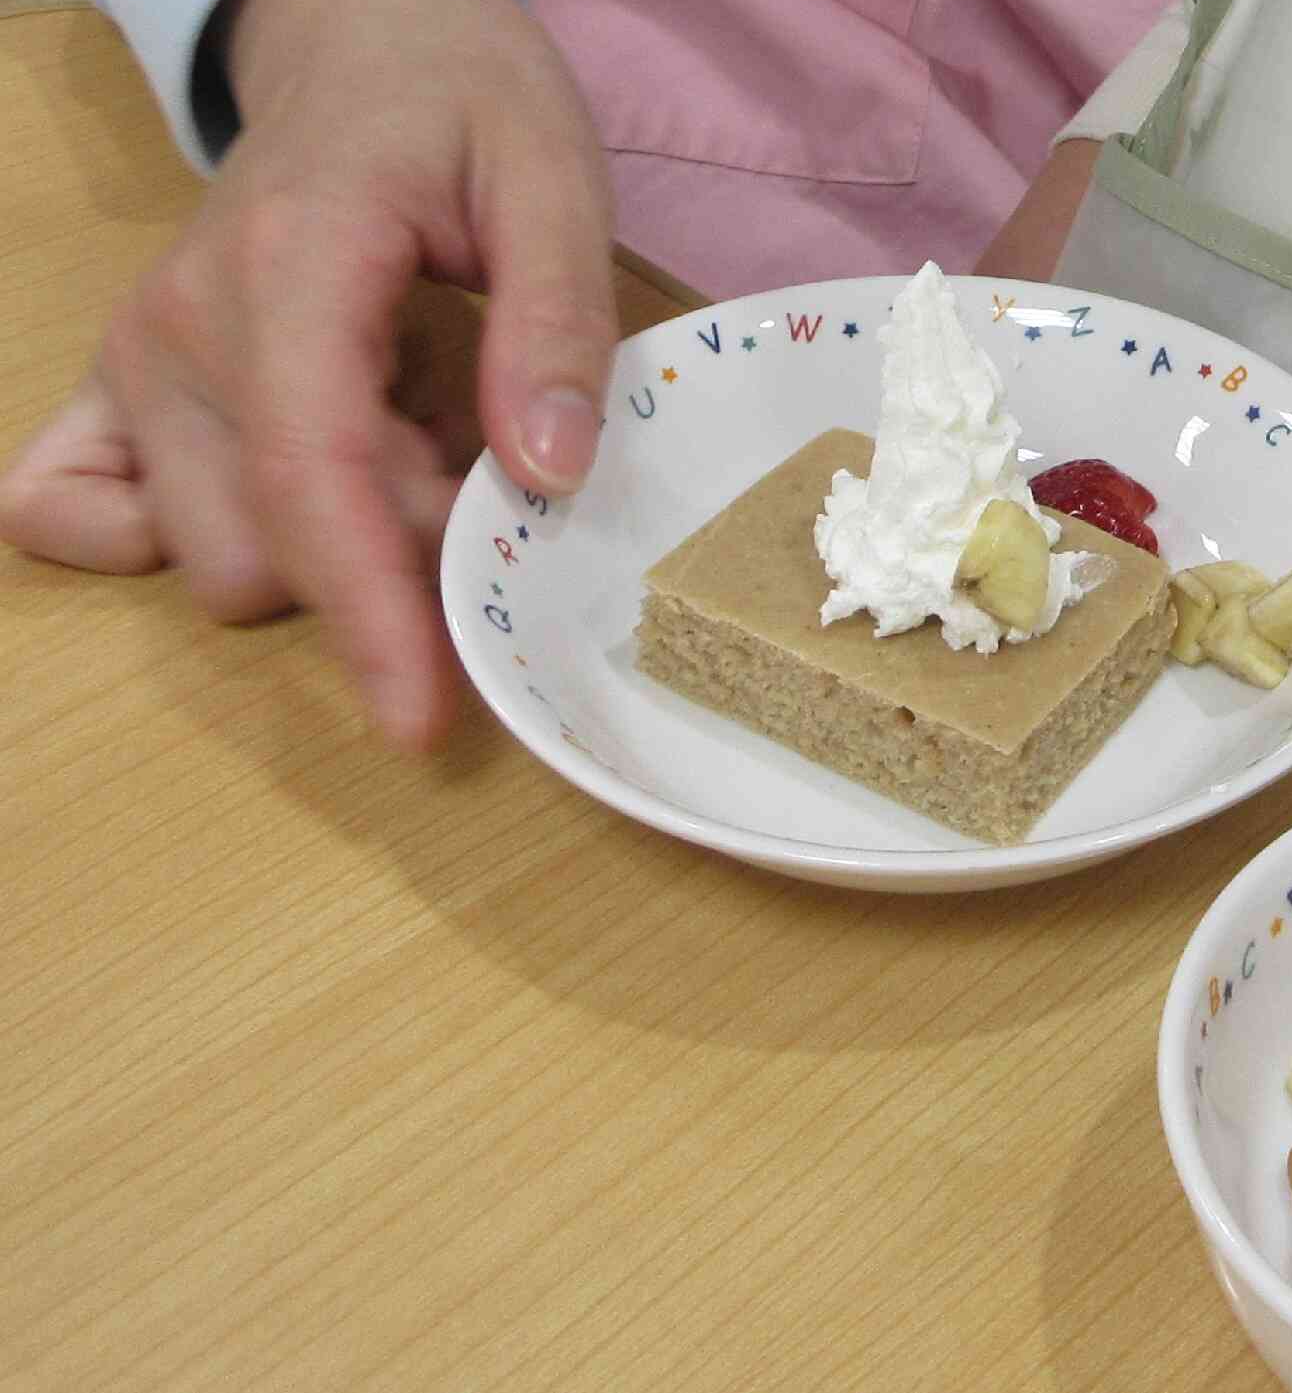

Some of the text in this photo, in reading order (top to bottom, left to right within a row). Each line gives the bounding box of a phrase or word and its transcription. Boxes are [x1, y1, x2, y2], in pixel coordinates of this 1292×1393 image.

[629, 387, 656, 419] U
[697, 322, 721, 354] V
[786, 312, 823, 343] W
[1067, 306, 1094, 337] Z
[1151, 347, 1172, 376] A
[1221, 365, 1247, 393] B
[1265, 424, 1291, 446] C
